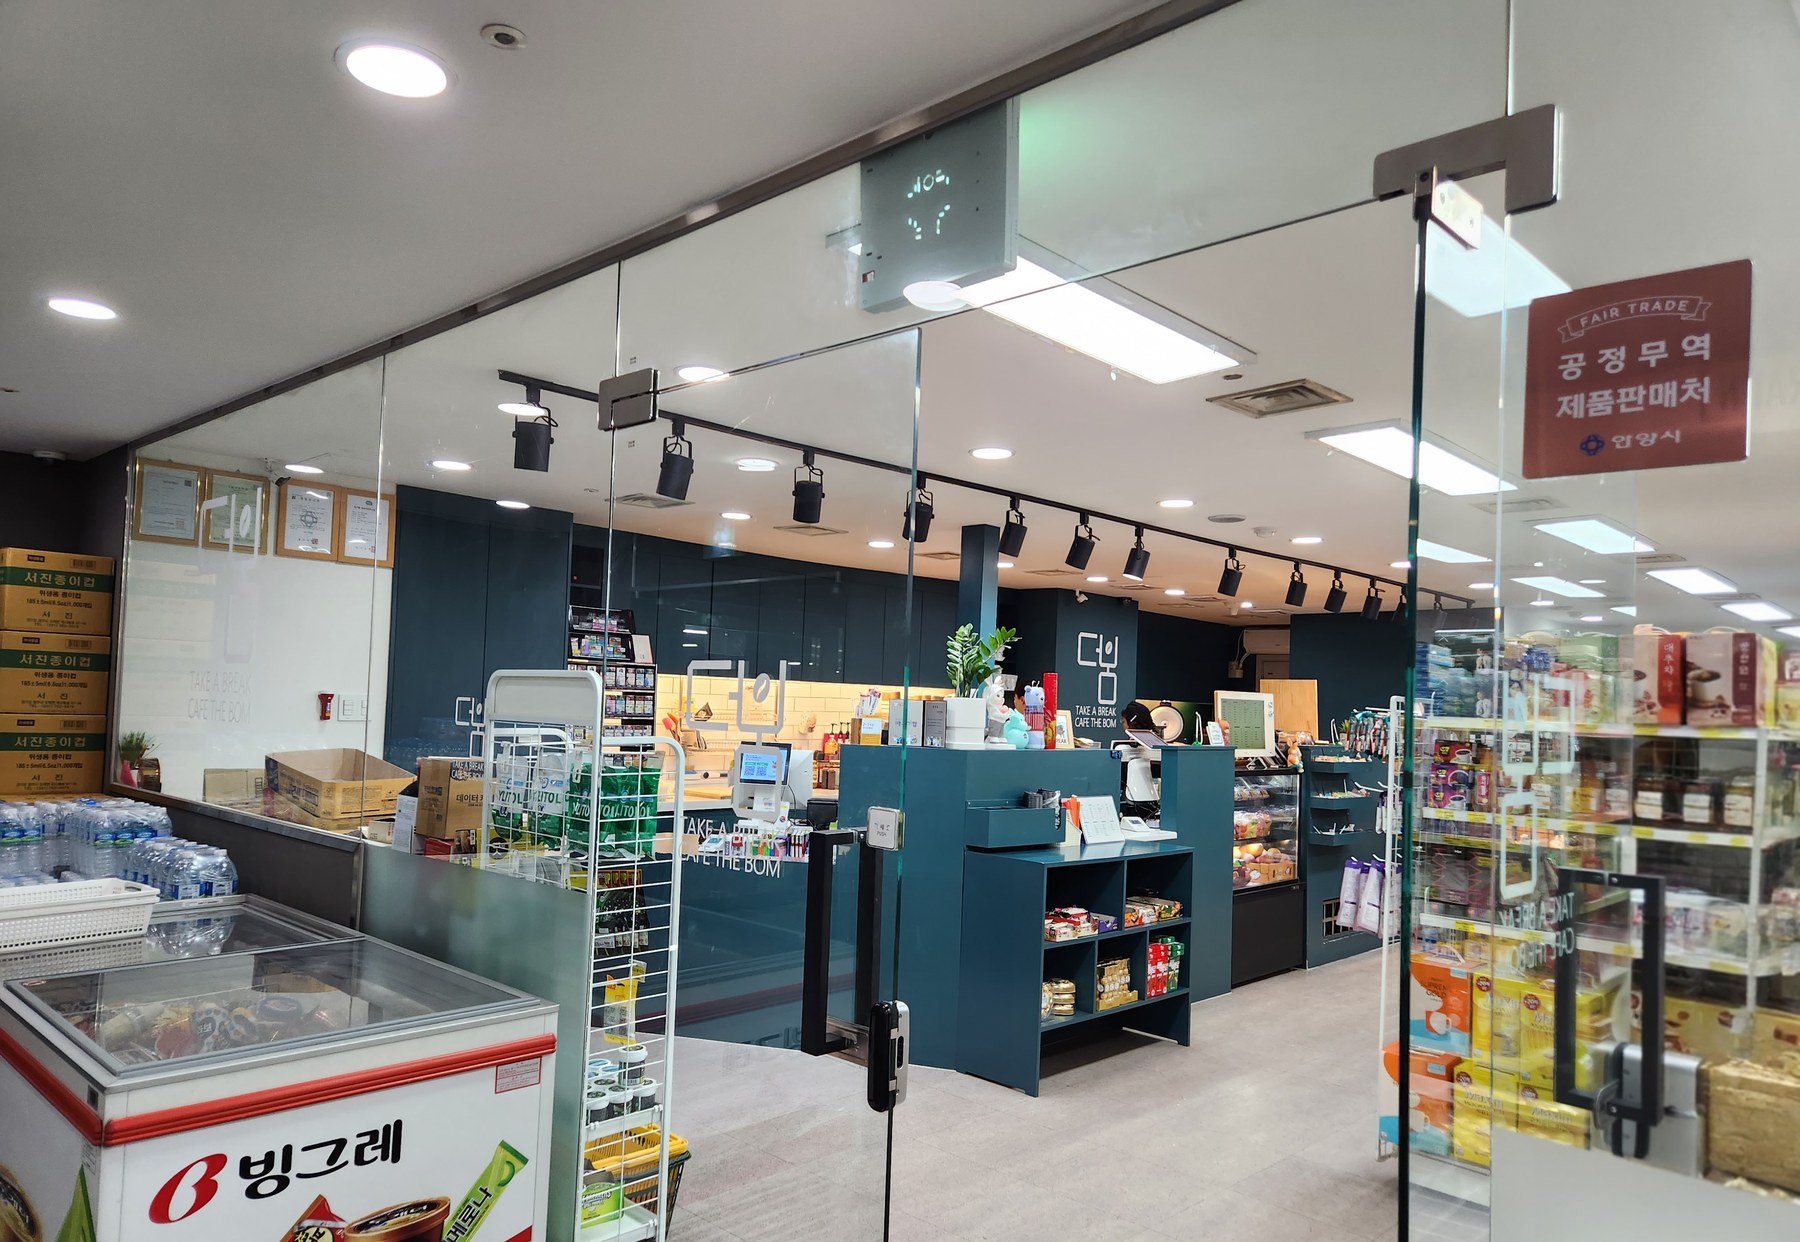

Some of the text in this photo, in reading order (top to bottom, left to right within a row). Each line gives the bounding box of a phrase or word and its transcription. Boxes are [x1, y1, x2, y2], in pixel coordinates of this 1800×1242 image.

[1579, 299, 1689, 329] FAIR TRADE
[1557, 333, 1711, 381] 공정무역
[1556, 376, 1711, 419] 제품판매처
[25, 572, 95, 588] 서진종이컵
[20, 654, 91, 668] 서진종이컵
[1074, 717, 1117, 728] CAFE THE BOM
[1075, 705, 1117, 717] TAKE A BREAK
[15, 736, 86, 748] 서진종이컵
[745, 853, 780, 879] BOM
[238, 1118, 404, 1200] 빙그레
[445, 1186, 493, 1242] 메로나
